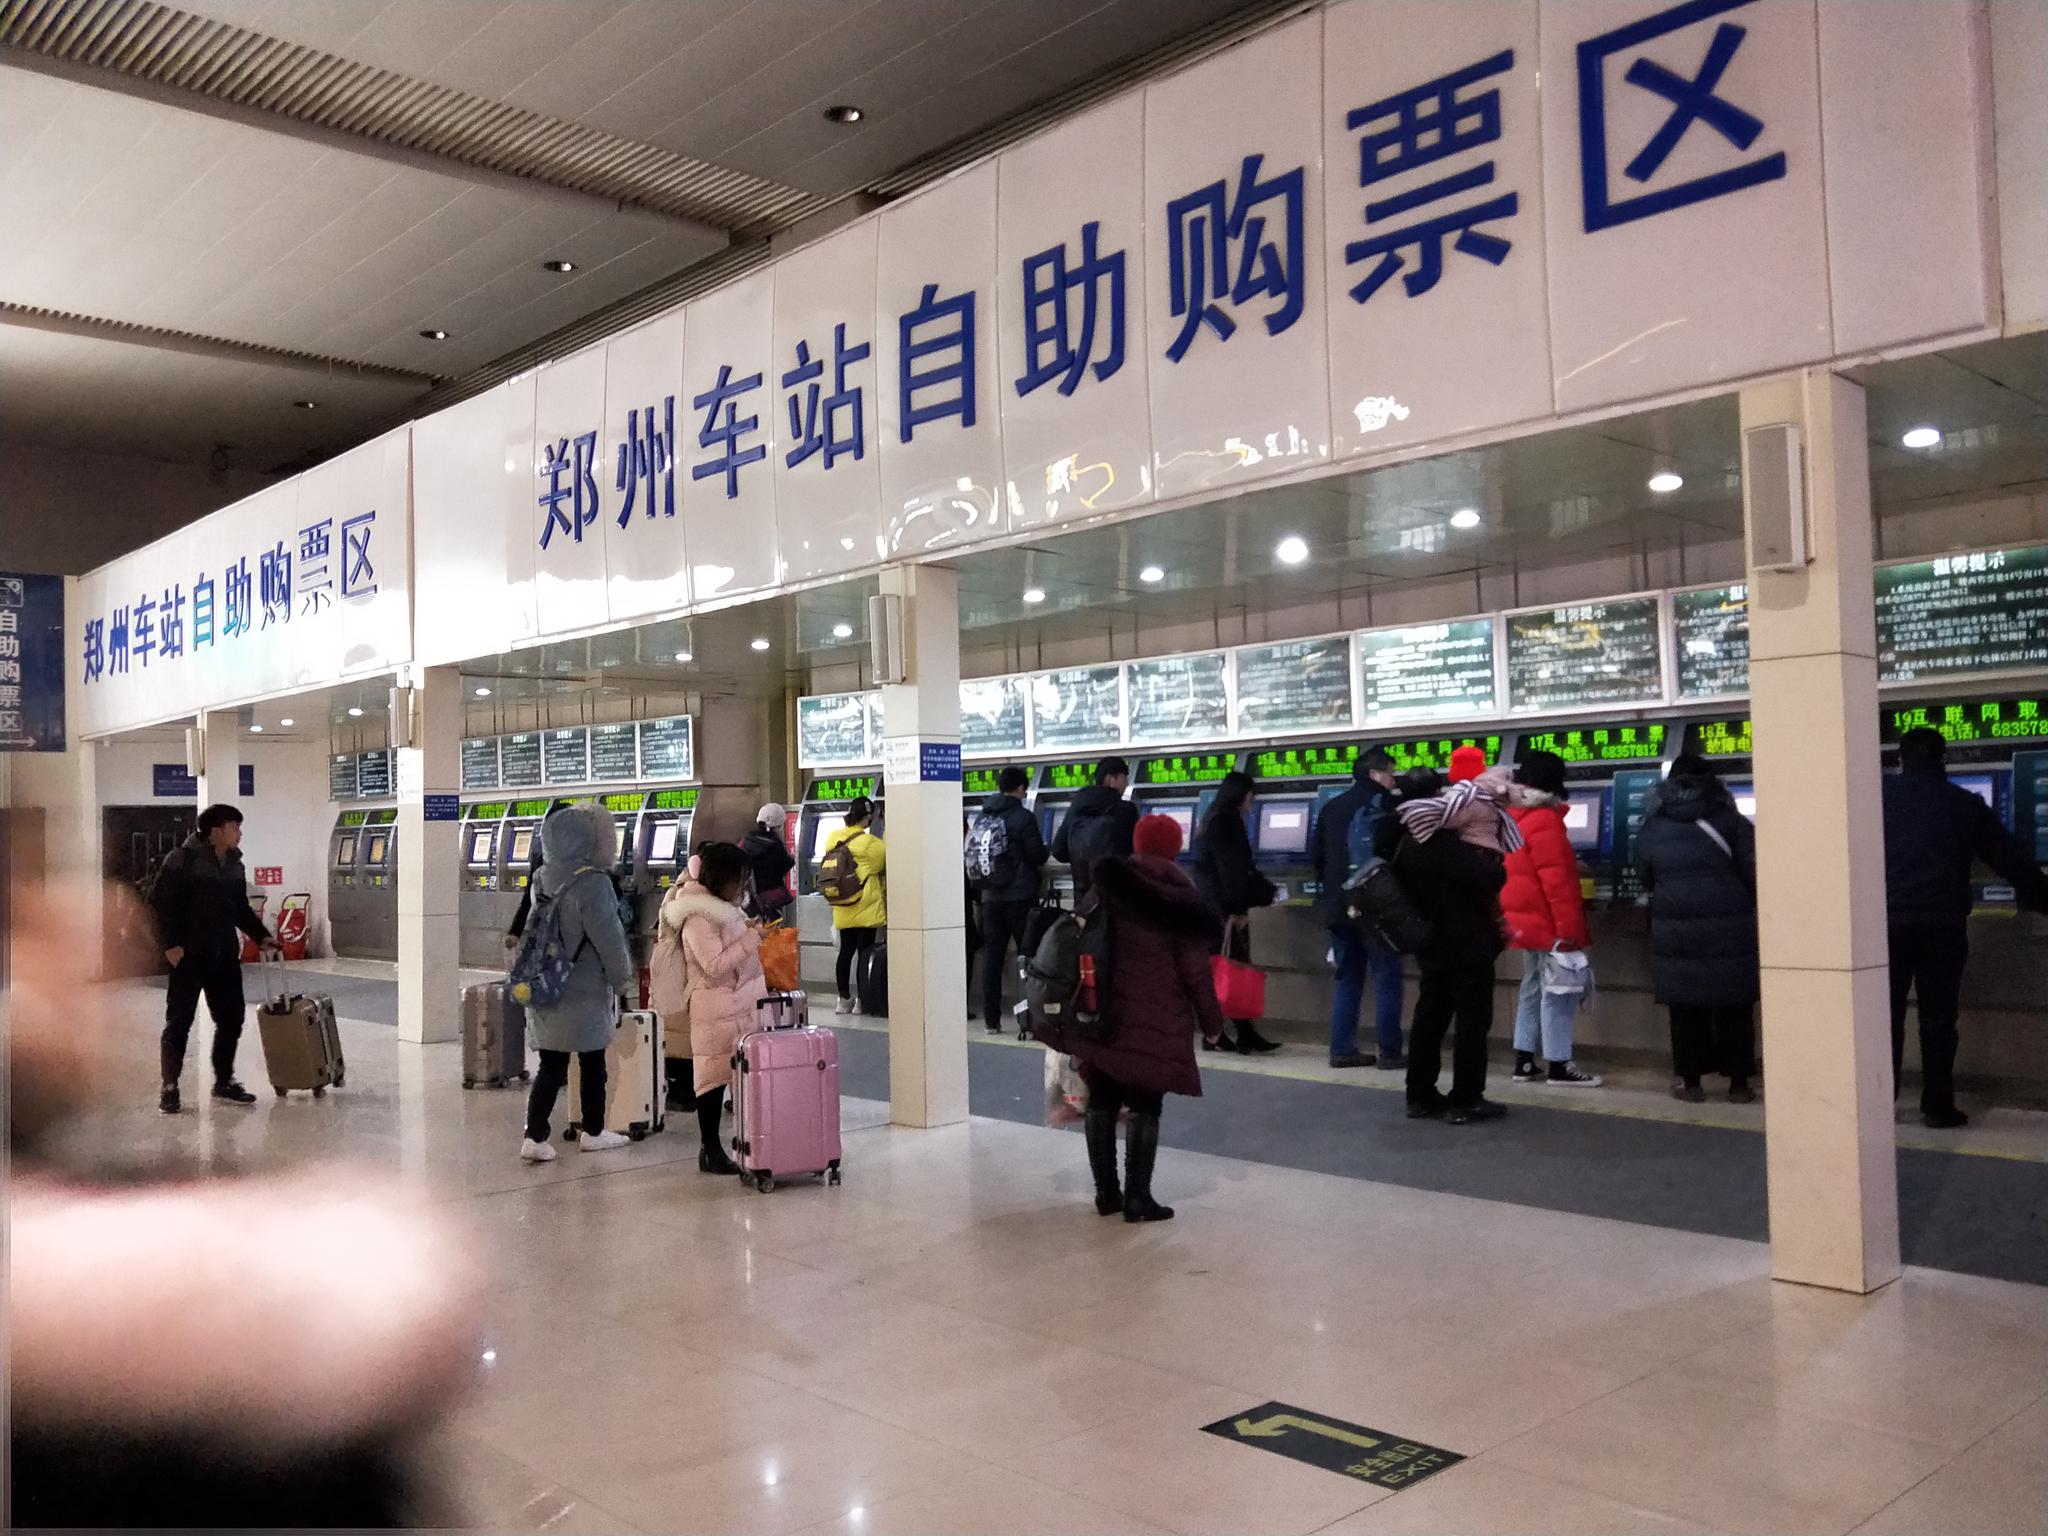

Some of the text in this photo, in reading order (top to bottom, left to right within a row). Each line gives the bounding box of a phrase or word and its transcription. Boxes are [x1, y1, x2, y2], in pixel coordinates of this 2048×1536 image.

[538, 0, 1787, 550] 郑州车站自助购票区
[0, 609, 21, 732] 自助购票区
[84, 510, 377, 684] 郑州车站自助购票区
[1380, 1453, 1445, 1484] EXIT
